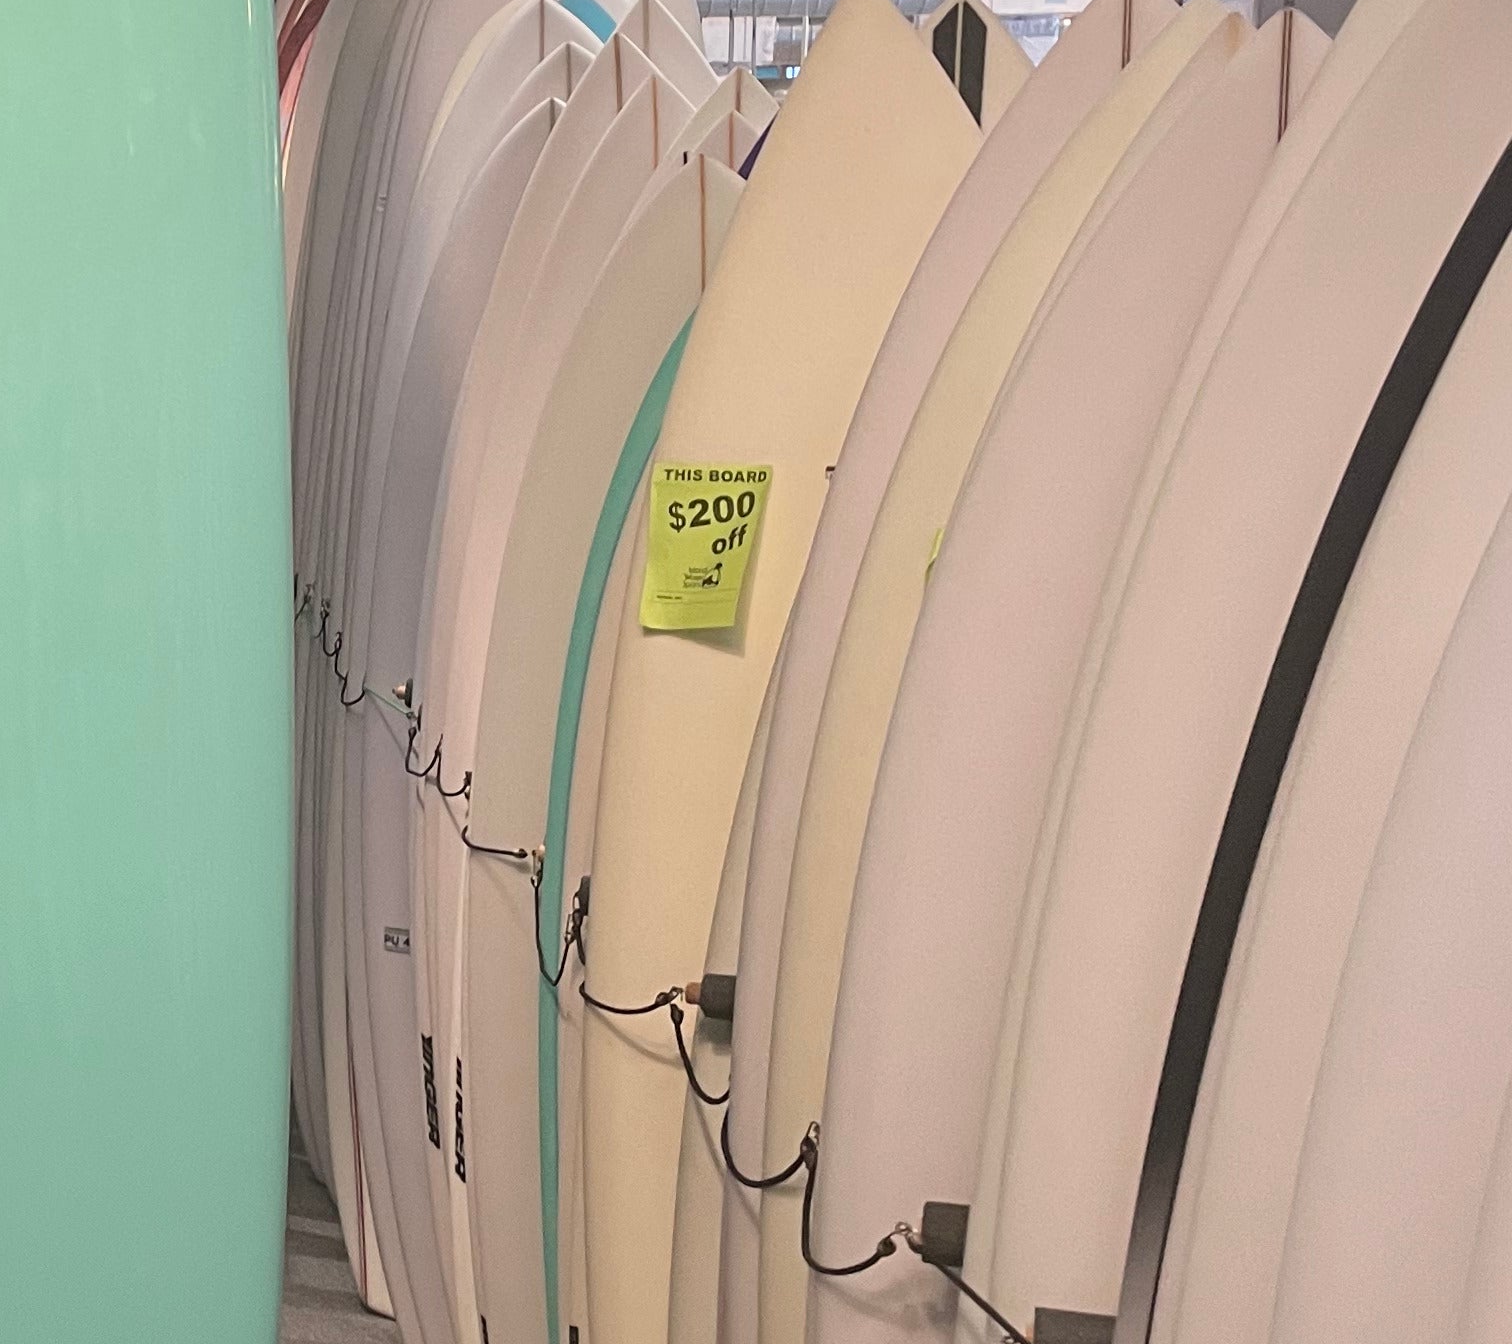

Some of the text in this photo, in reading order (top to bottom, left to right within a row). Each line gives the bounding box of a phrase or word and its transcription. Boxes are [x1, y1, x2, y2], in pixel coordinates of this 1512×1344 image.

[664, 469, 767, 483] THIS BOARD
[668, 491, 756, 533] $200
[711, 523, 748, 555] off
